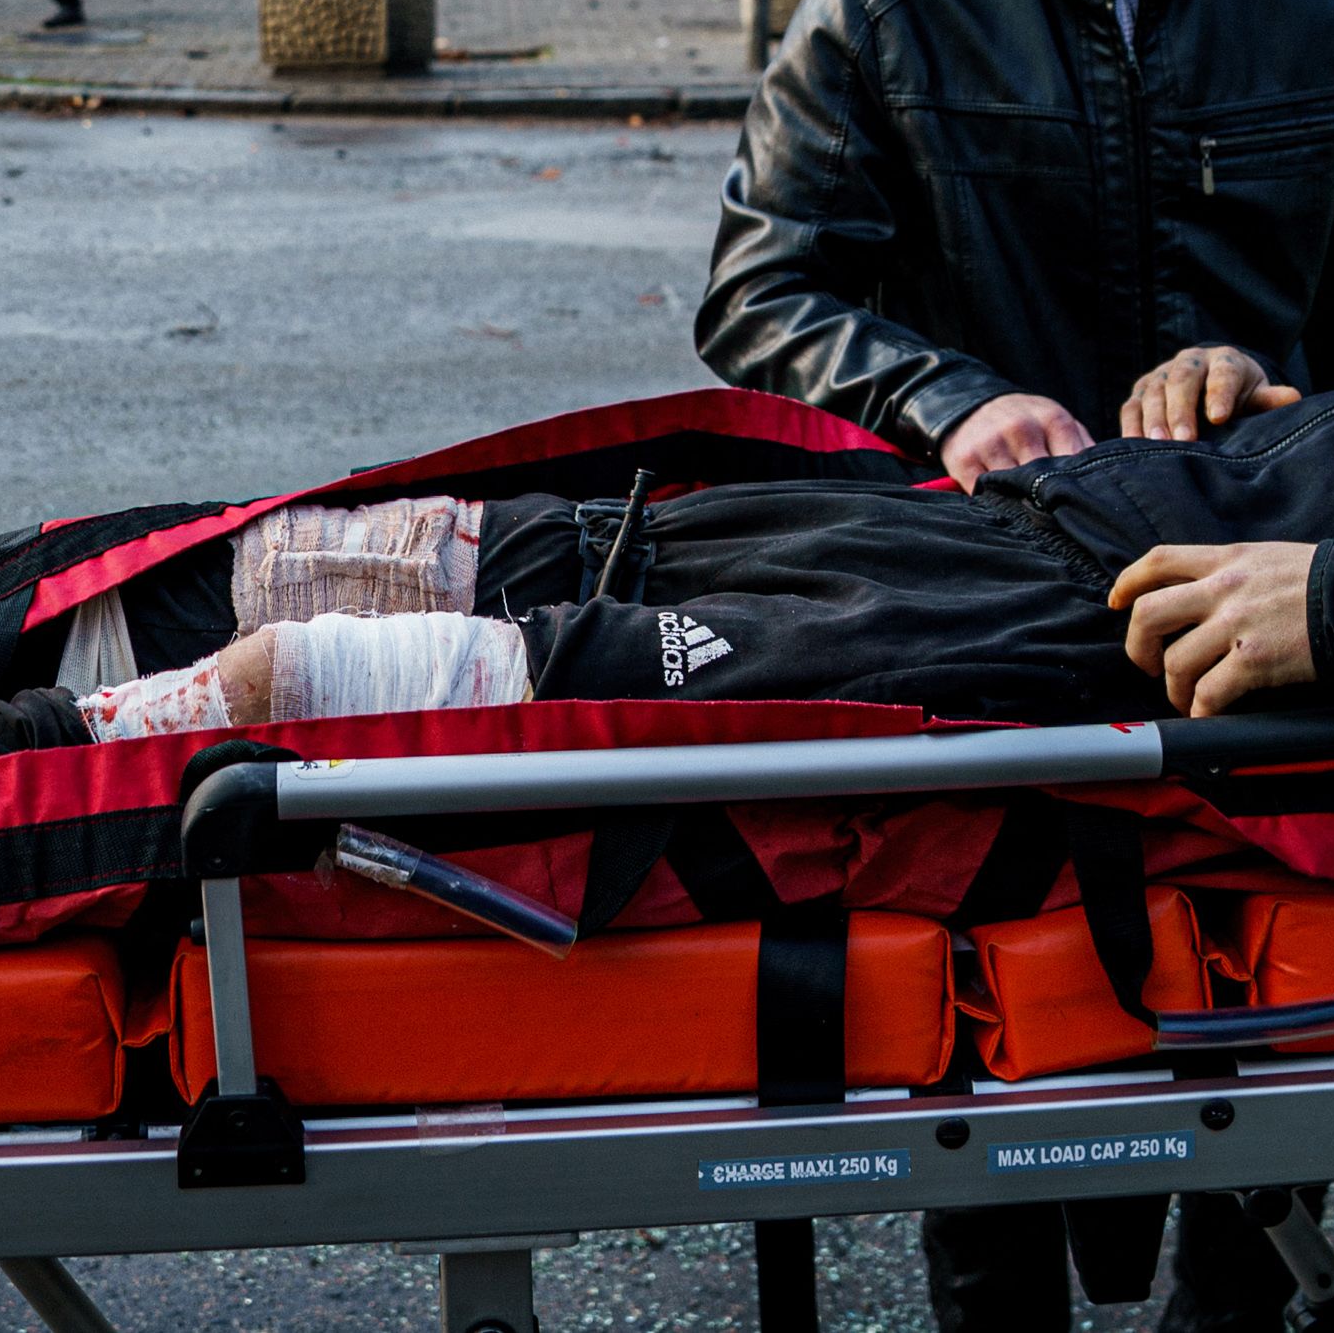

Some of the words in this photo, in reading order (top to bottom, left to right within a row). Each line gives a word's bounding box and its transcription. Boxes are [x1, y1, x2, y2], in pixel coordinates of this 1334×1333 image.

[657, 612, 687, 686] adidas
[997, 1148, 1036, 1167] MAX
[1041, 1144, 1086, 1164] LOAD
[1090, 1141, 1126, 1160] CAP
[1129, 1138, 1160, 1158] 250
[1165, 1137, 1187, 1158] Kg
[713, 1162, 785, 1183] CHARGE
[790, 1159, 835, 1179] MAXI
[839, 1156, 870, 1175] 250
[875, 1155, 898, 1176] Kg
